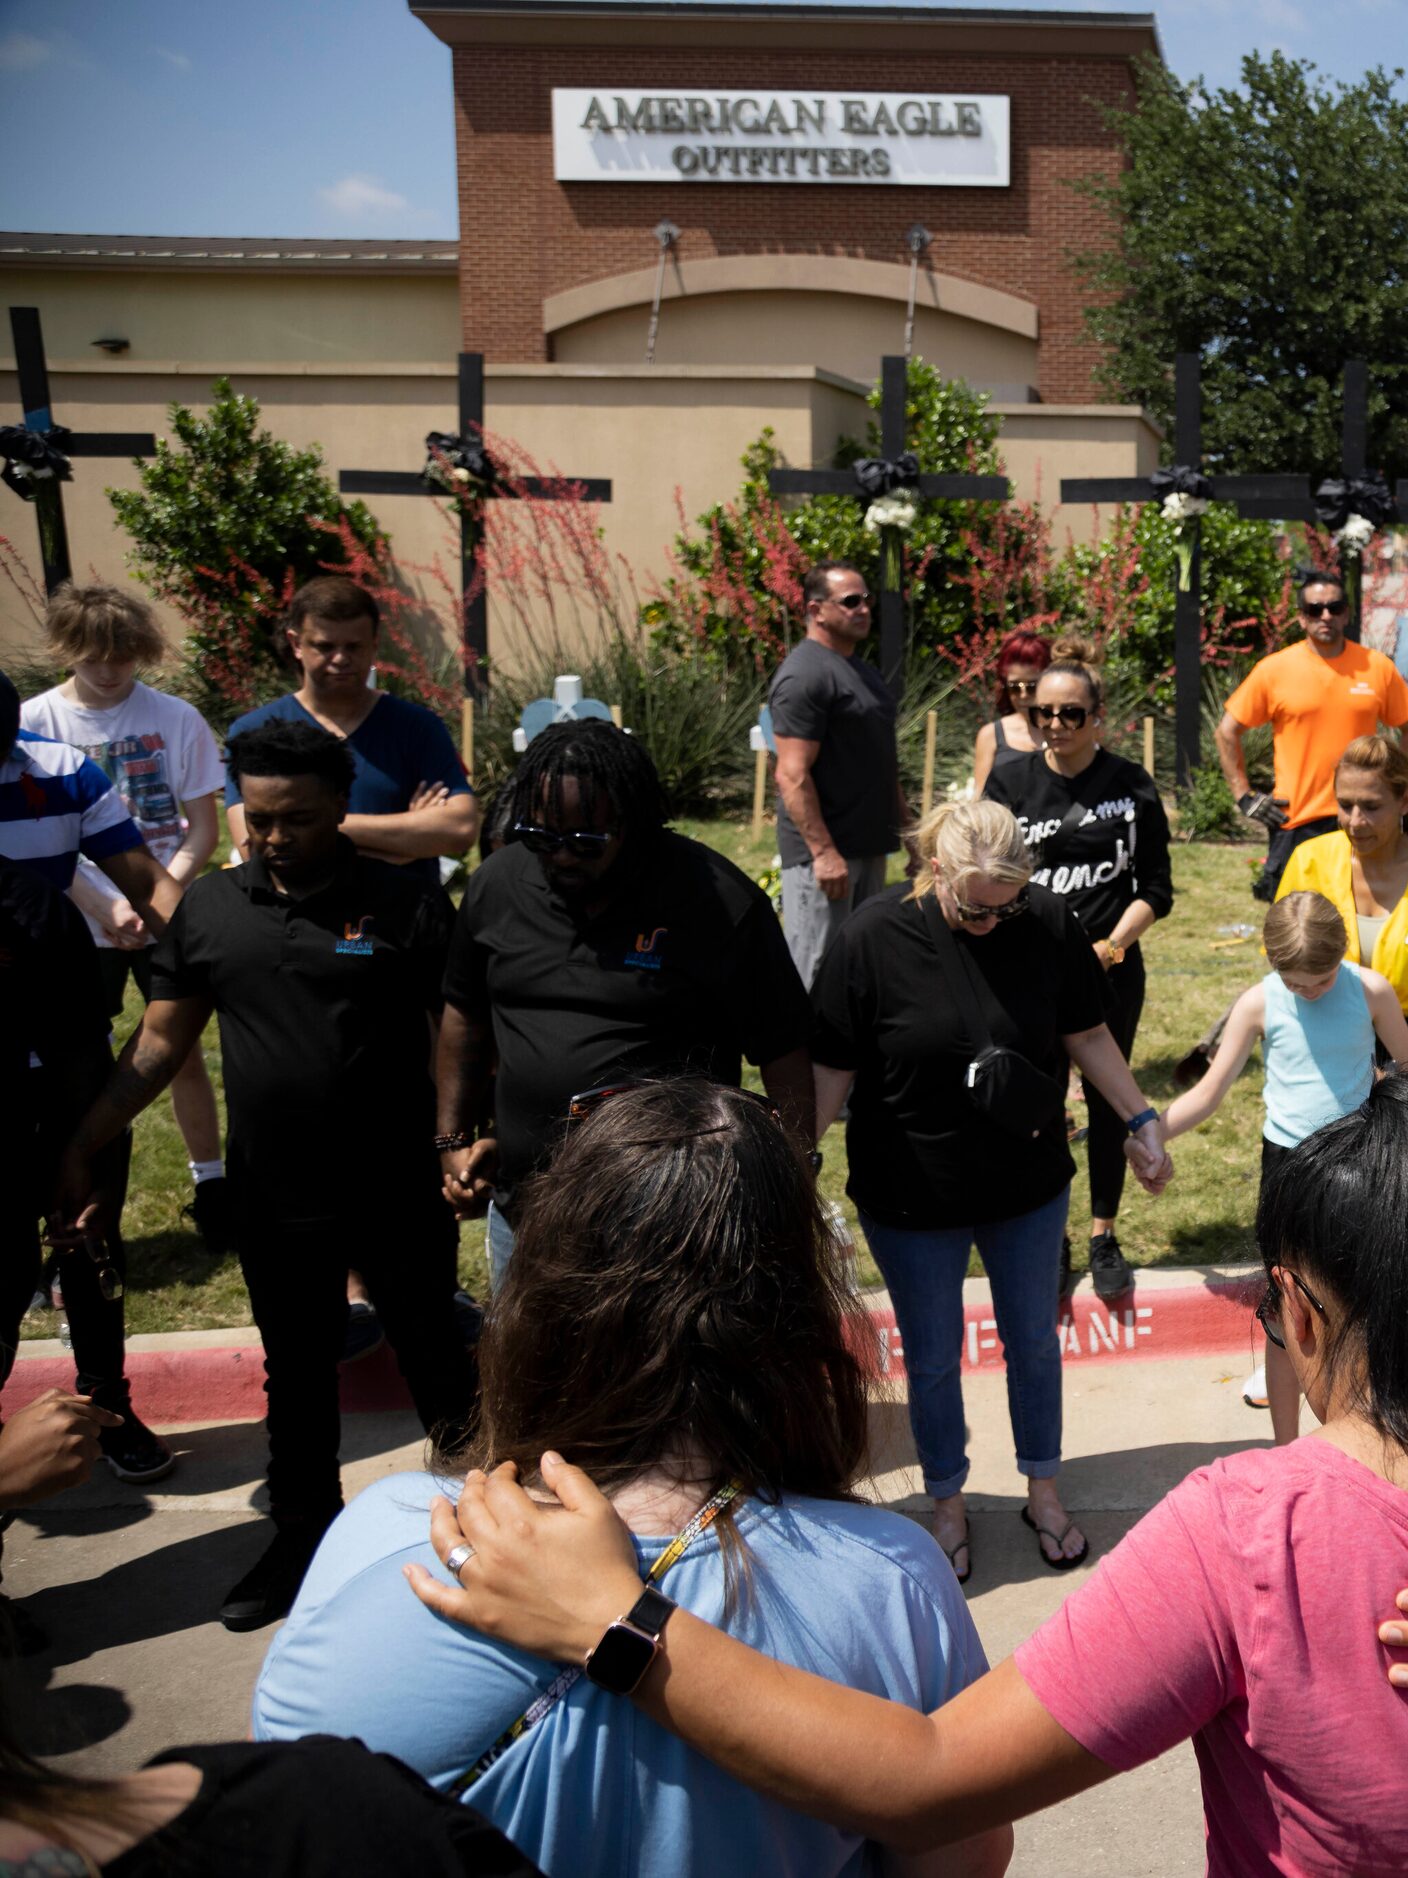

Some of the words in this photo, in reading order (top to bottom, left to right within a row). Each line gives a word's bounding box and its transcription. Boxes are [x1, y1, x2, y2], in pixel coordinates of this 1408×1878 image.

[580, 97, 826, 136] AMERICAN
[841, 100, 982, 138] EAGLE
[672, 145, 891, 177] OUTFITTERS
